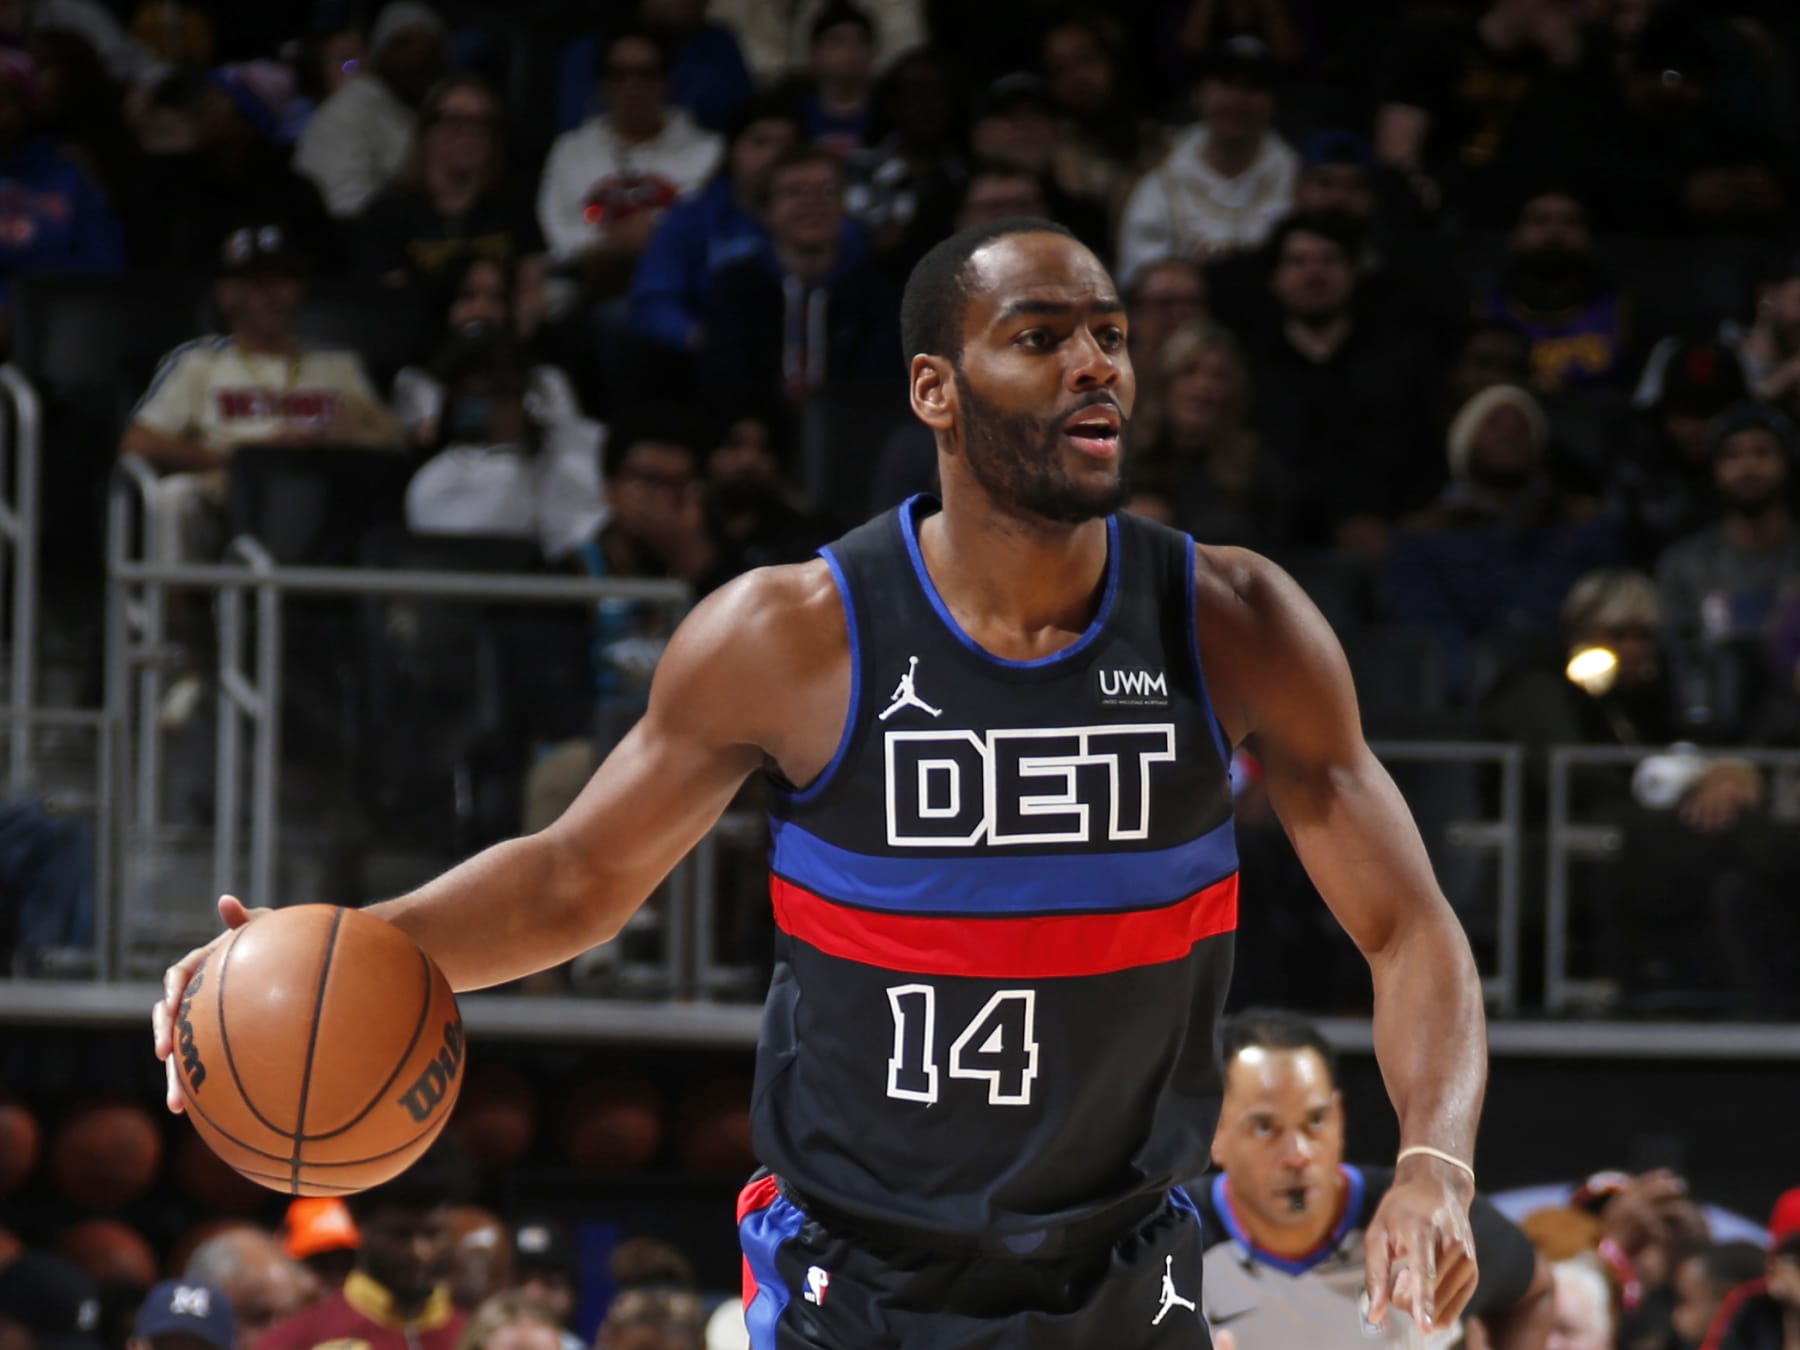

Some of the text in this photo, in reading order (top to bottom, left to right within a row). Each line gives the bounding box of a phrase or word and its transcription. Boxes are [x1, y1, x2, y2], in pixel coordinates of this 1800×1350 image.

[1099, 670, 1168, 696] UWM
[885, 723, 1175, 846] DET
[887, 984, 1038, 1105] 14
